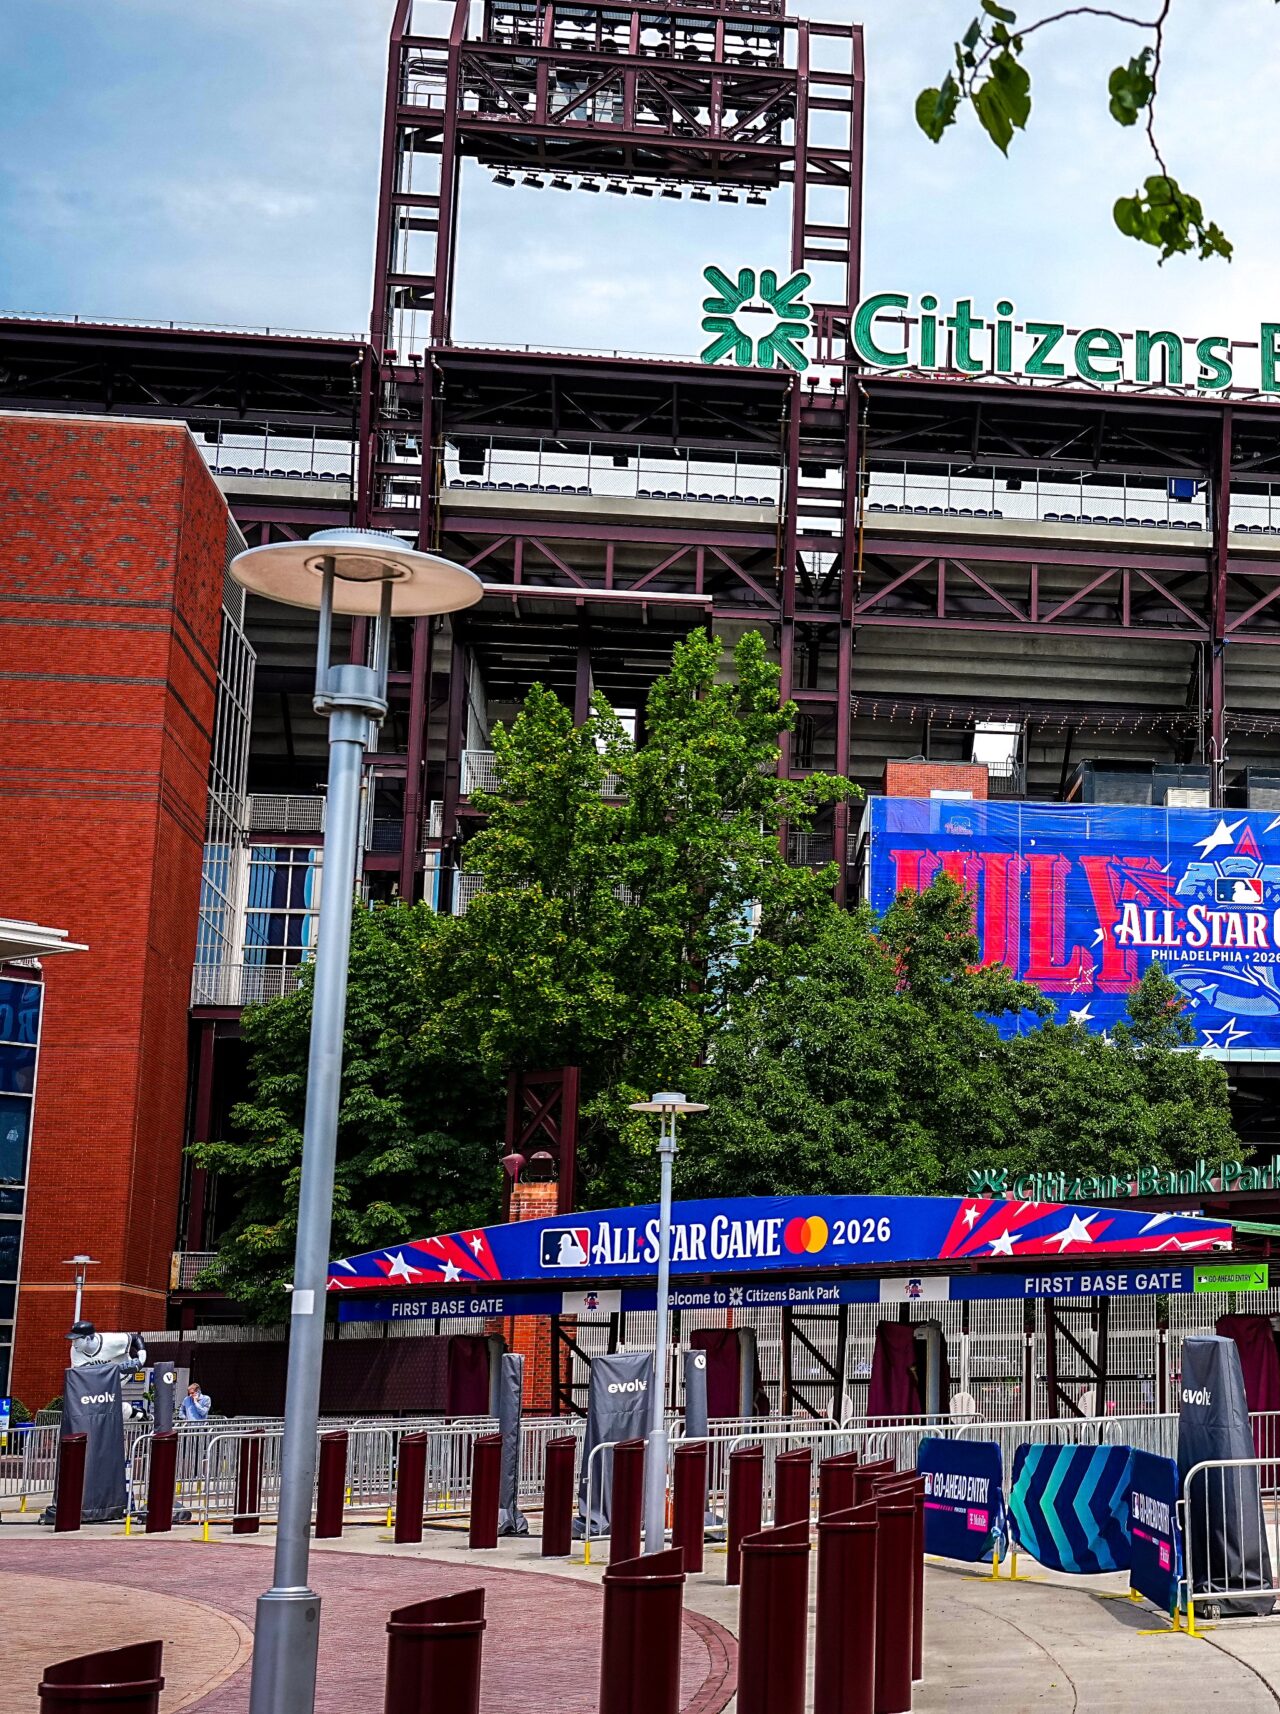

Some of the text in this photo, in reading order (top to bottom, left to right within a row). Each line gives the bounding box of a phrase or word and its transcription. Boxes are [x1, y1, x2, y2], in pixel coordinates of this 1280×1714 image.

[853, 292, 1233, 390] Citizens
[1114, 902, 1182, 948] ALL
[1185, 904, 1270, 949] STAR
[1151, 949, 1243, 963] PHILADELPHIA
[1013, 1170, 1133, 1202] Citizens
[1137, 1159, 1216, 1197] Bank
[592, 1221, 641, 1265] ALL
[710, 1214, 783, 1260] GAME
[832, 1216, 891, 1245] 2026
[1024, 1272, 1183, 1294] FIRST BASE GATE
[1235, 1273, 1252, 1282] ENTRY
[391, 1298, 504, 1317] FIRST BASE GATE
[660, 1285, 840, 1306] elcome to Citizens Bank Park
[933, 1472, 990, 1504] GO-AHEAD ENTRY
